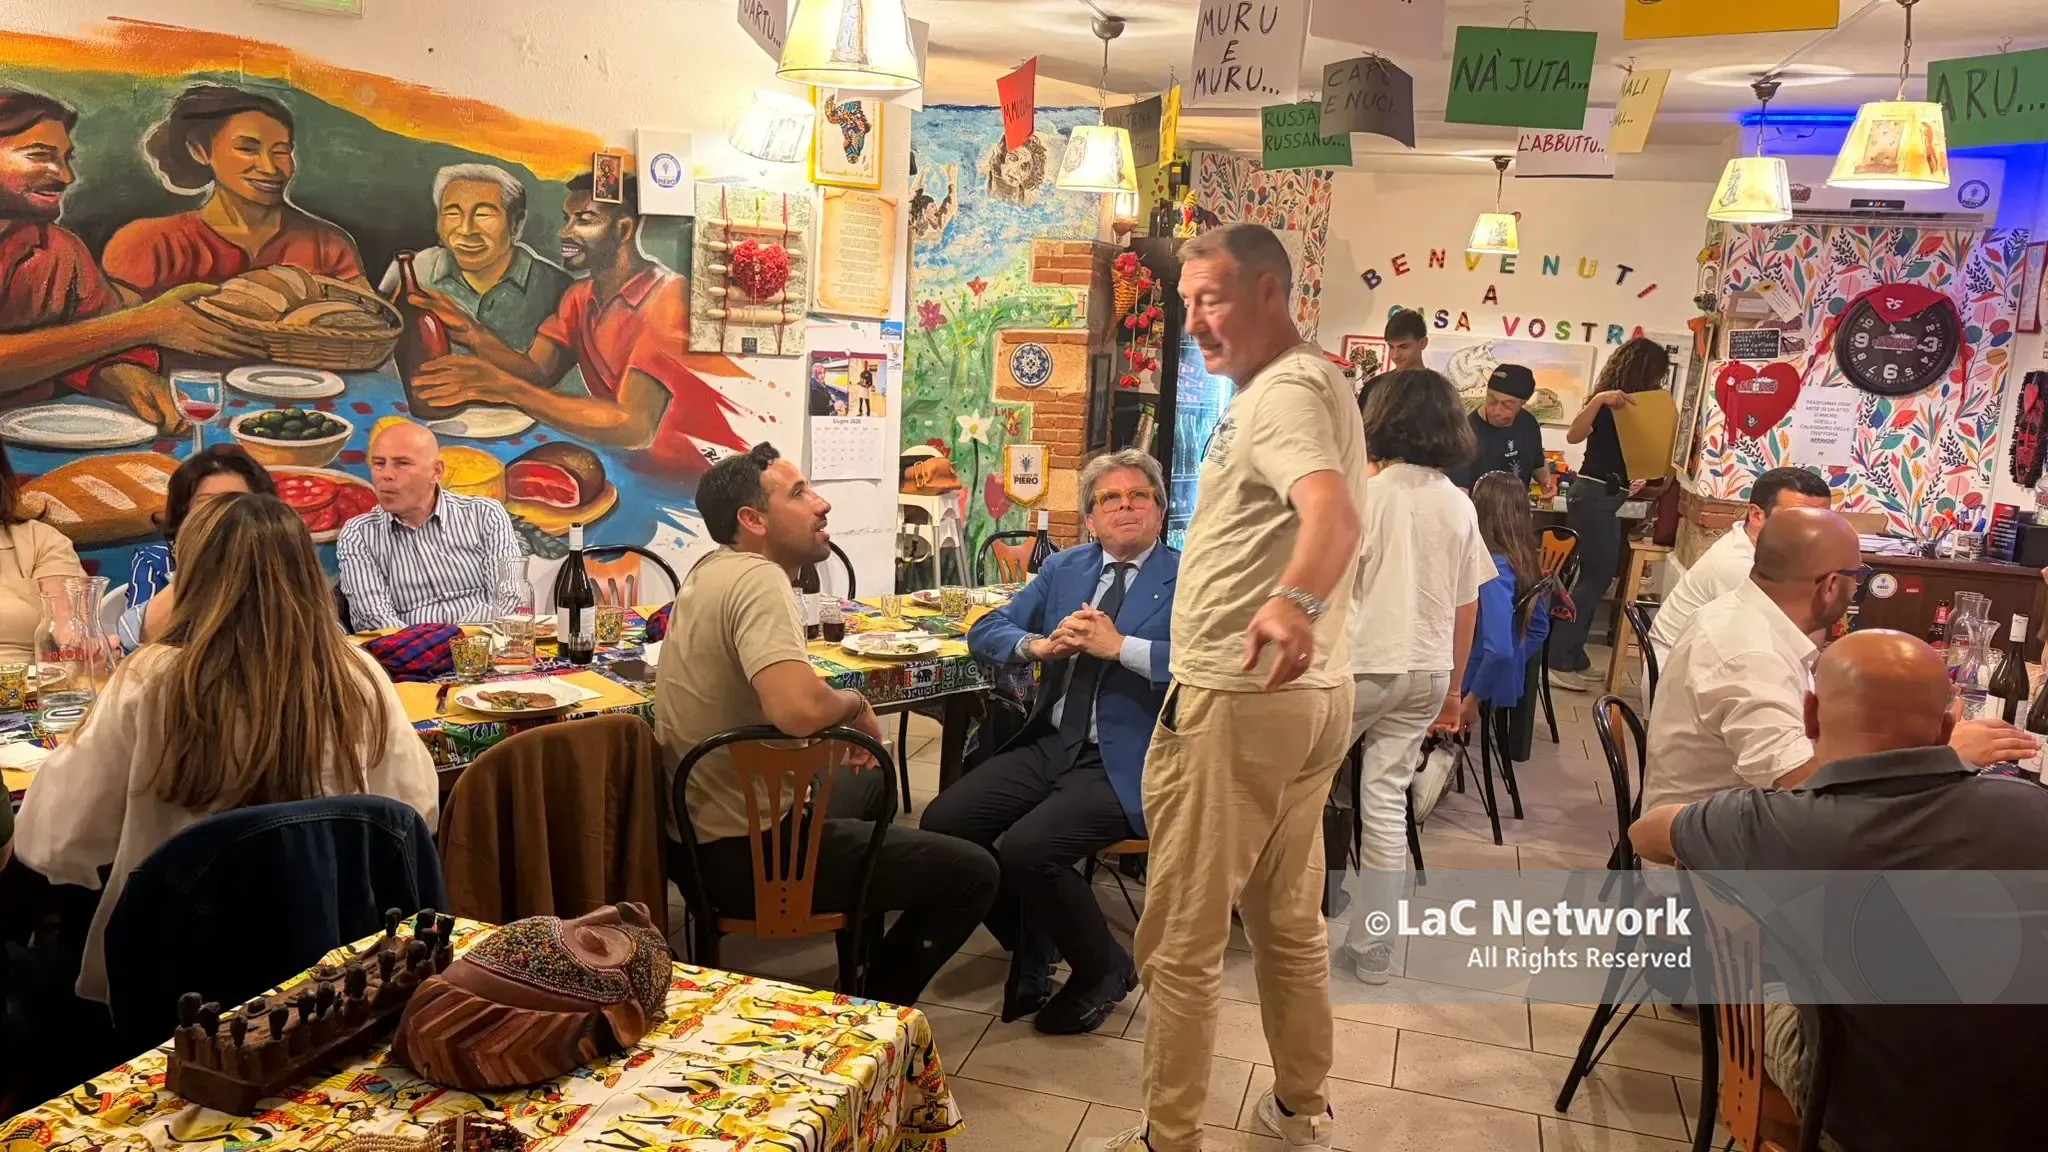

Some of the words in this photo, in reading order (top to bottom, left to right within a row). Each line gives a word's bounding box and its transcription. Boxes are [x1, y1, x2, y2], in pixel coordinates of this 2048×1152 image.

[1199, 1, 1278, 43] MURU
[1221, 39, 1240, 64] E
[1192, 64, 1281, 100] MURU...
[1324, 95, 1340, 115] E
[1264, 109, 1321, 131] RUSSA
[1482, 284, 1499, 305] A
[1387, 304, 1471, 332] CSA
[1502, 315, 1648, 346] VOSTRA
[1854, 331, 1870, 349] 9
[1922, 336, 1939, 353] 3
[1882, 363, 1899, 380] 6
[1014, 477, 1039, 485] PIERO
